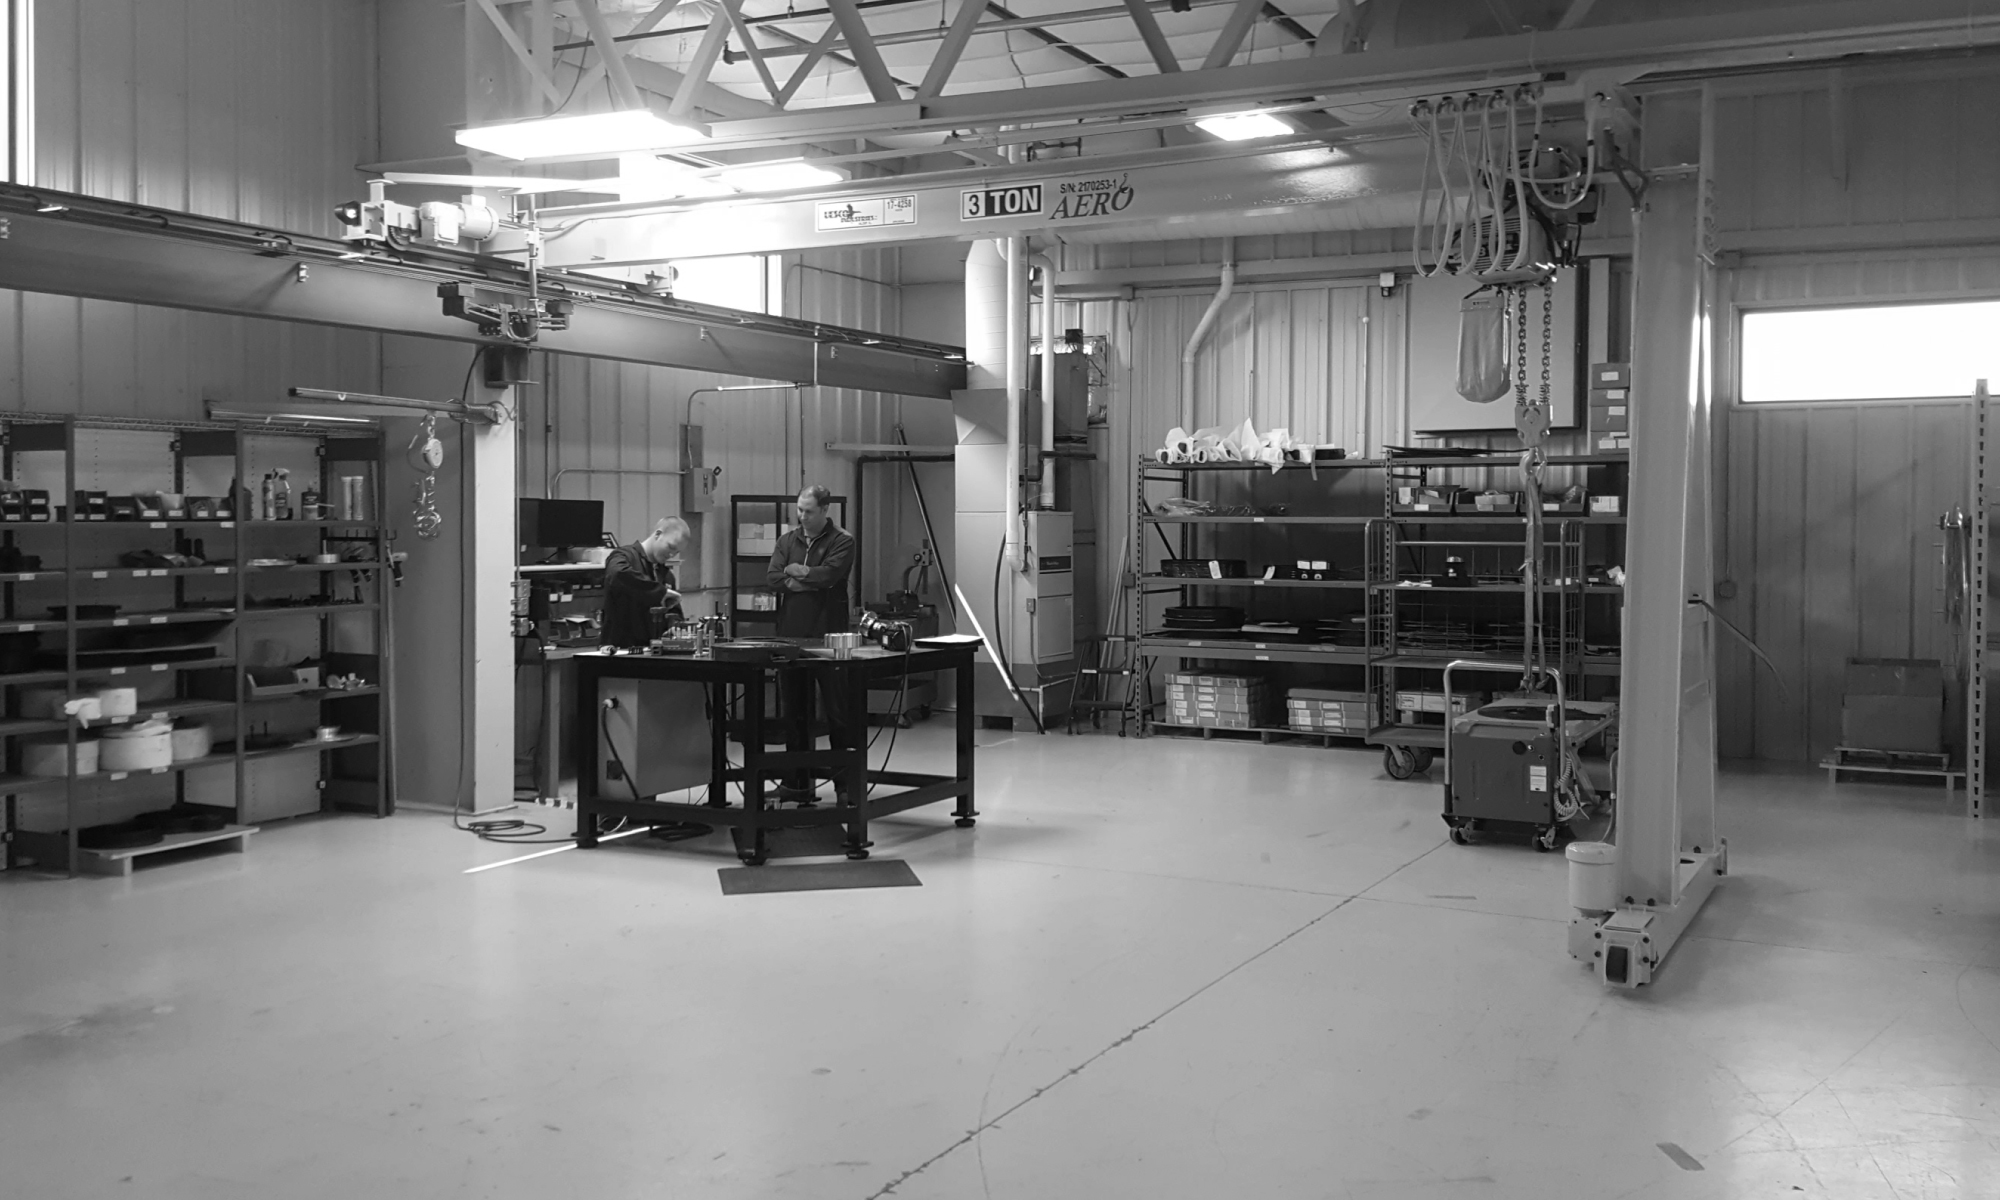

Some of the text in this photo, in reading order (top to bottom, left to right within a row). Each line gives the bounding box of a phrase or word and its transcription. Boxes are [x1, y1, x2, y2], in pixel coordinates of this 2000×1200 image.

[1078, 178, 1117, 192] 2170253-1
[968, 187, 1039, 216] 3 TON
[1048, 186, 1135, 220] AERO
